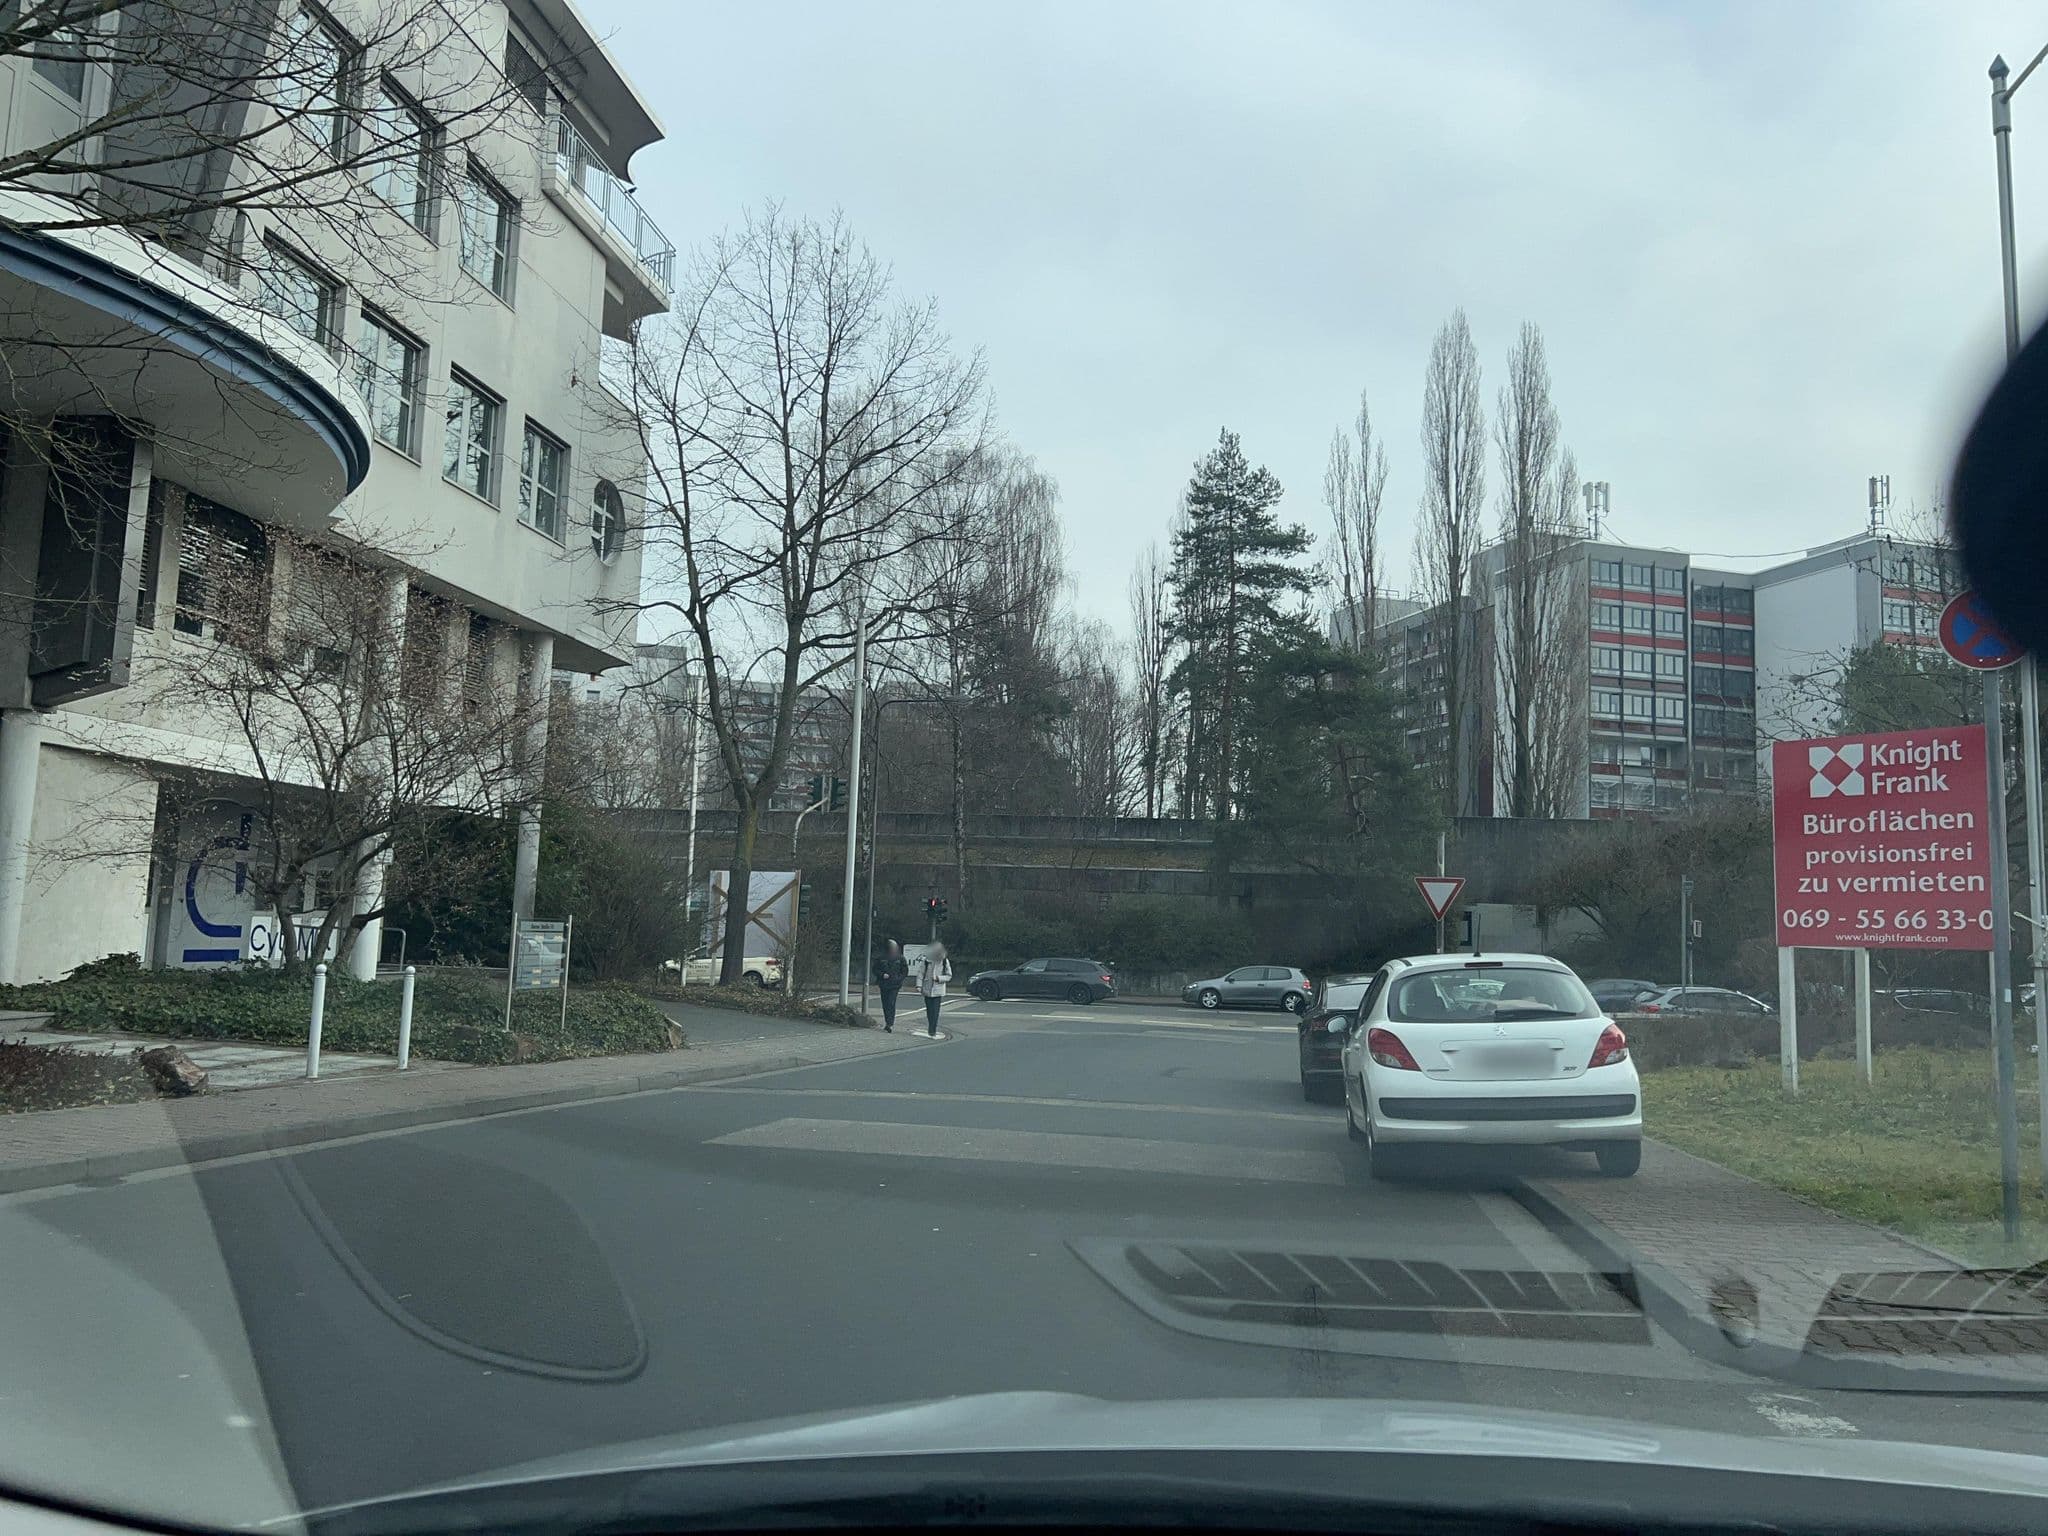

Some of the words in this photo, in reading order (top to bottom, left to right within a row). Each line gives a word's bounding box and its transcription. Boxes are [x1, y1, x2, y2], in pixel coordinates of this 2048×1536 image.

[1870, 739, 1963, 770] Knight
[1871, 768, 1950, 795] Frank
[1803, 807, 1974, 835] Büroflächen
[1805, 841, 1973, 870] provisionsfrei
[1798, 876, 1828, 893] zu
[1836, 870, 1985, 893] vermieten
[1782, 908, 1830, 928] 069
[1855, 908, 1886, 930] 55
[1893, 909, 1928, 930] 66
[1834, 931, 1949, 944] www.knightfrank.com
